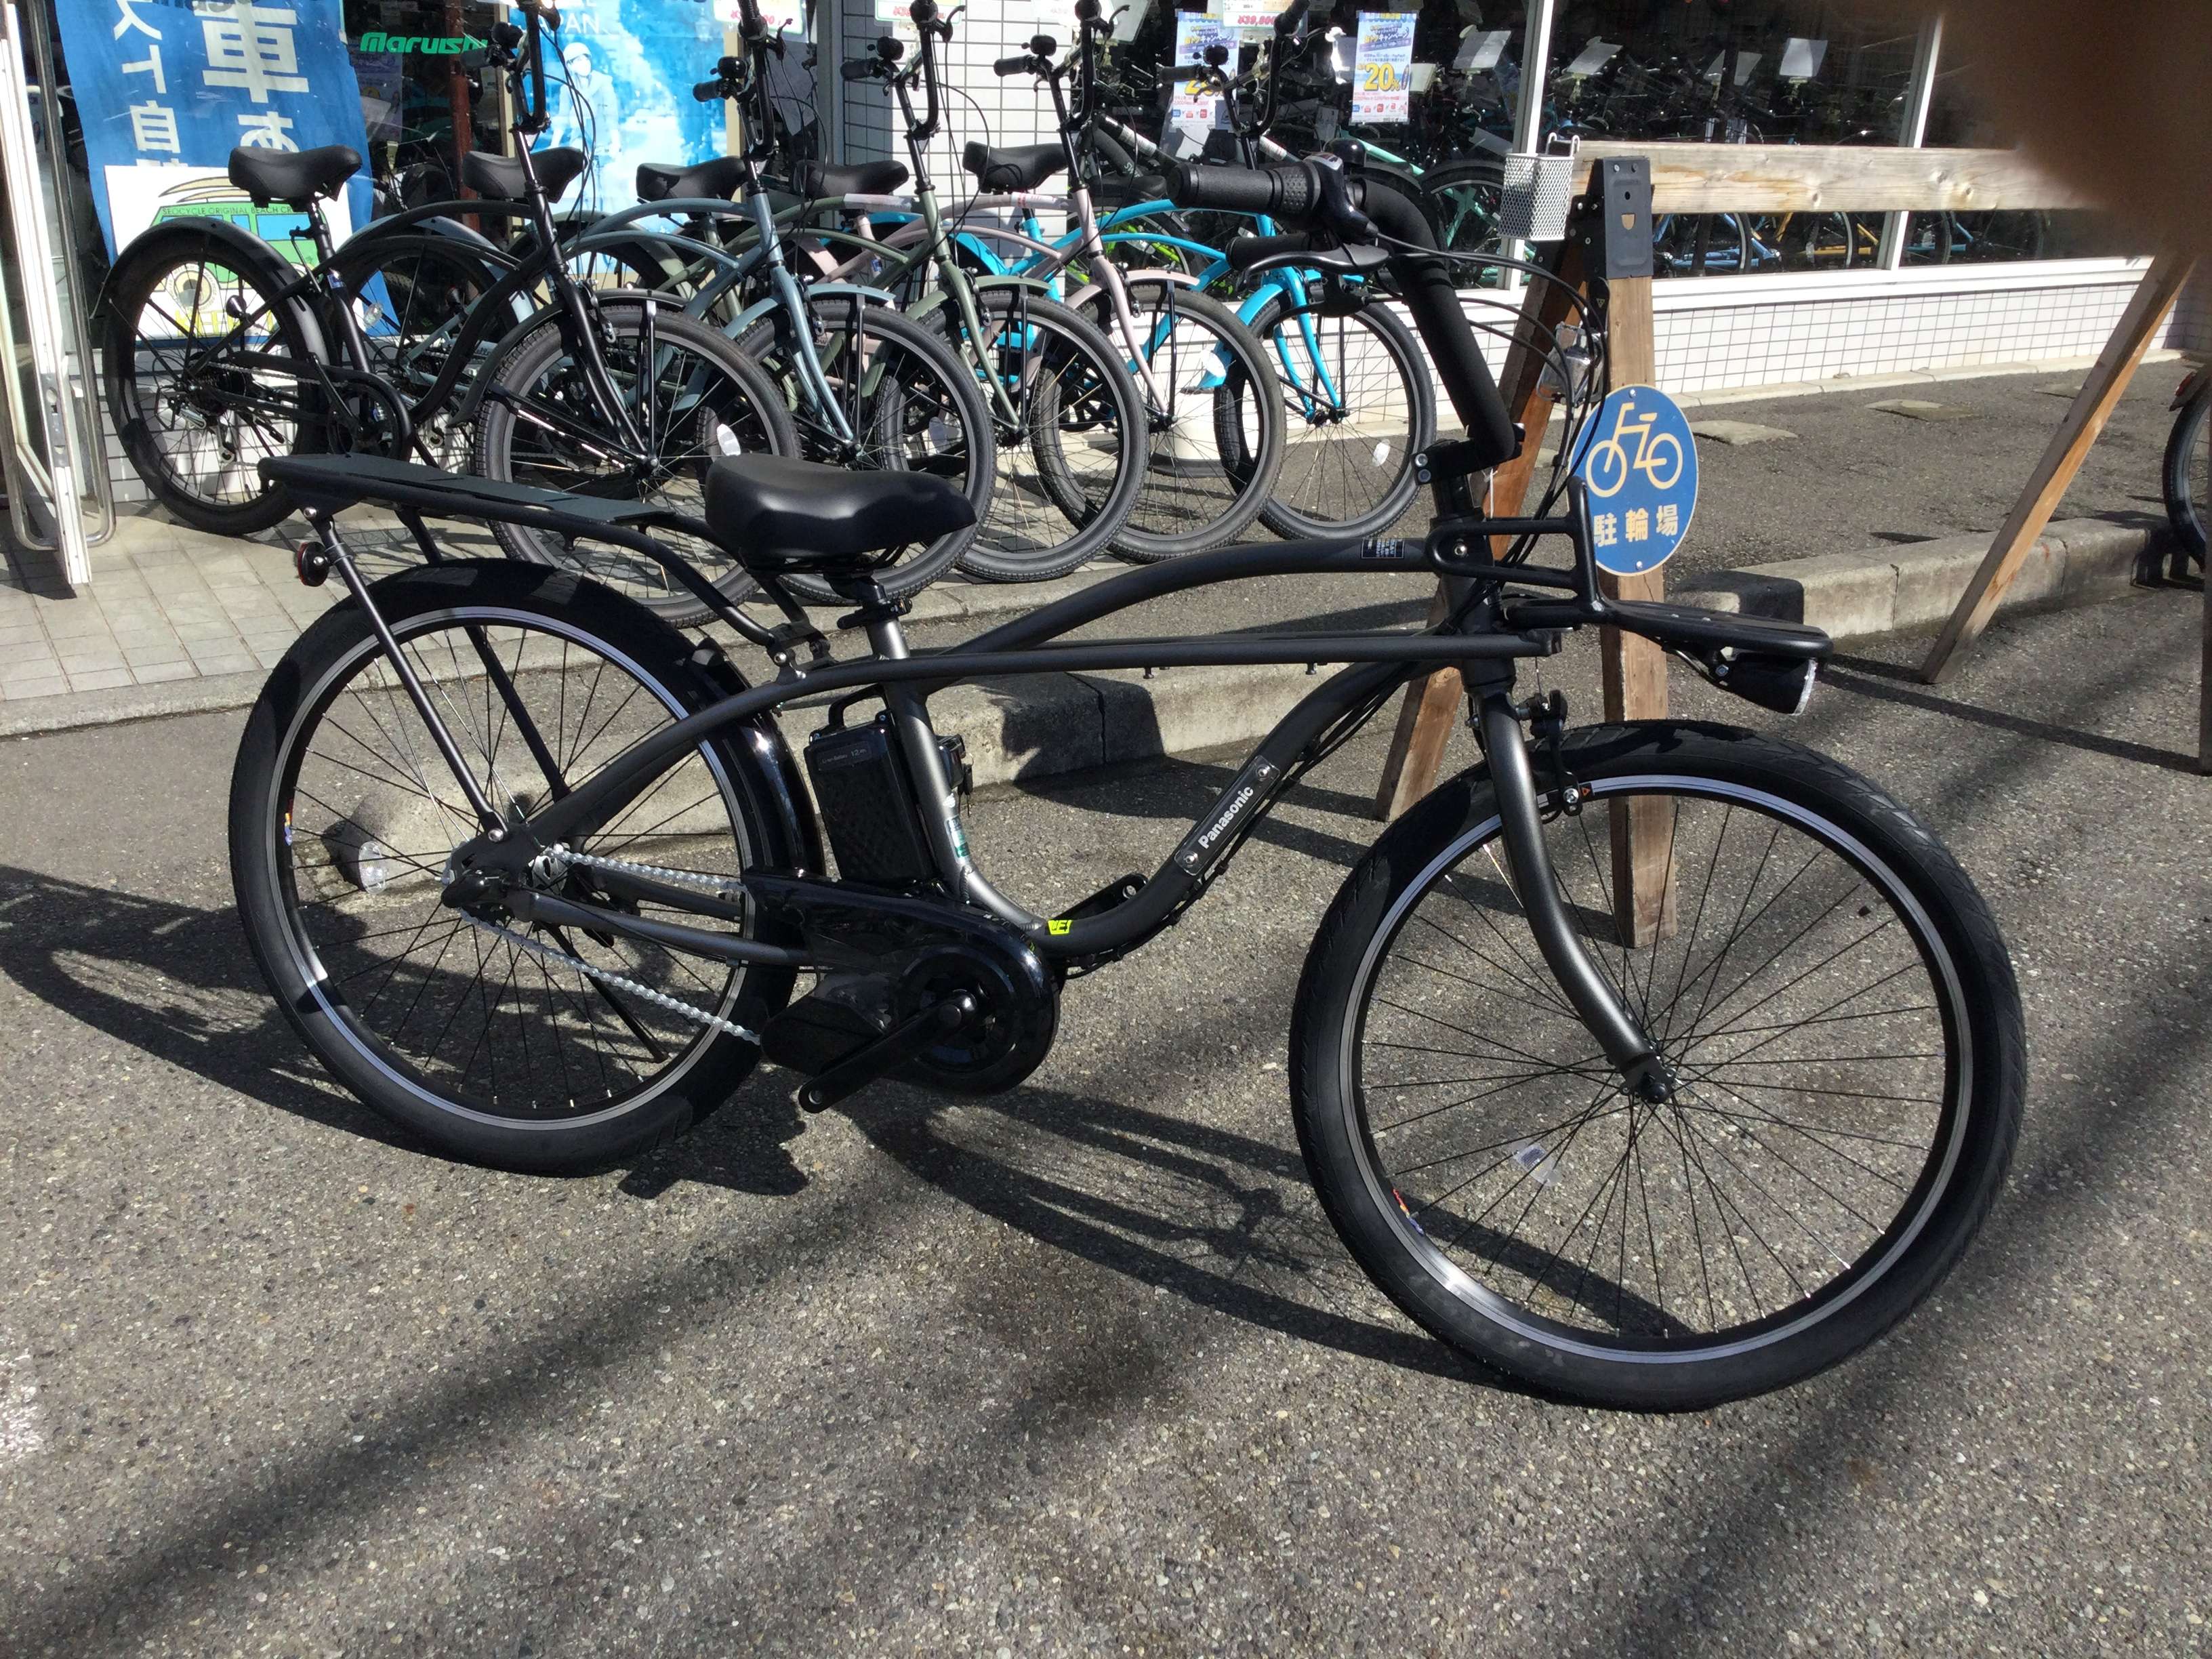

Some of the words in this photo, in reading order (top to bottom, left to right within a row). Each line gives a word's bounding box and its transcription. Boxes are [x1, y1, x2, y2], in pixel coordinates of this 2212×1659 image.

[1364, 62, 1400, 91] 20%
[251, 206, 279, 214] BEACH
[1593, 504, 1679, 548] 駐輪場
[1197, 786, 1254, 849] Panasonic
